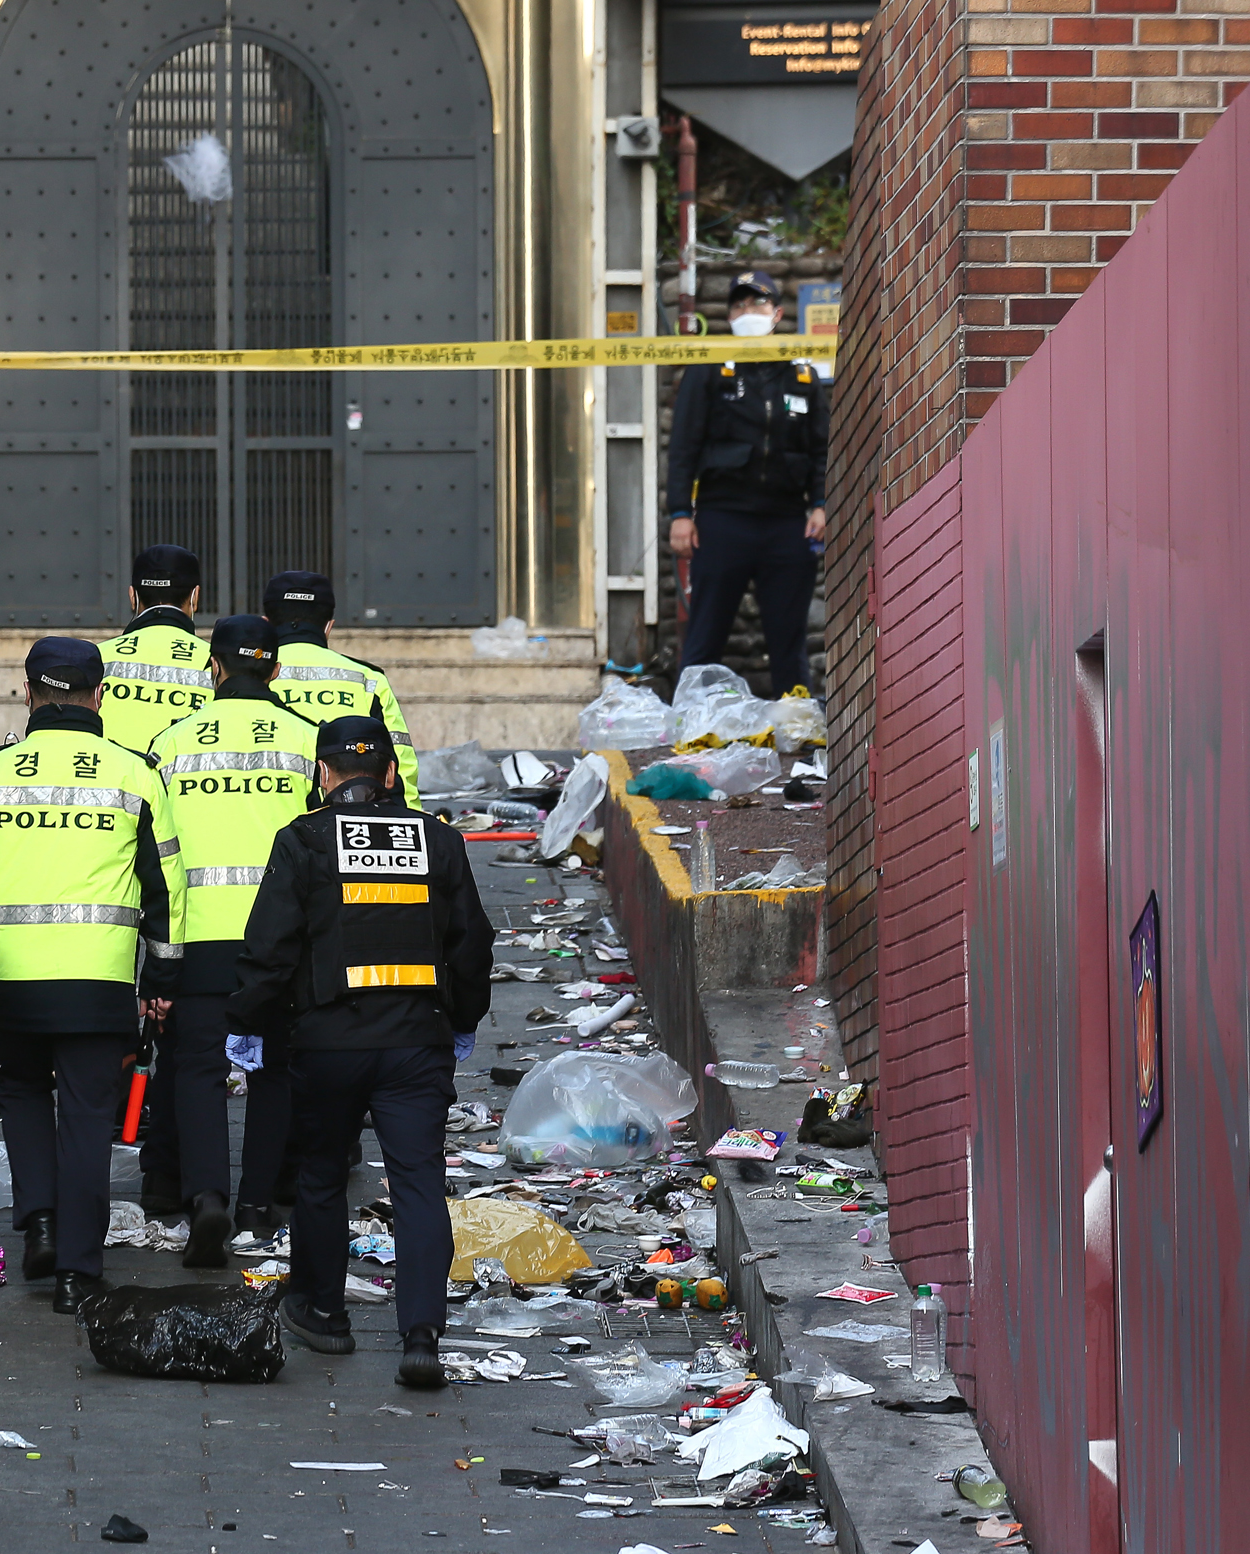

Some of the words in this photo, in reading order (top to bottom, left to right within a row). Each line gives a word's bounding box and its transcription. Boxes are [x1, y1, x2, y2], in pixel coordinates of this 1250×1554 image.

[143, 579, 168, 587] POLICE
[42, 675, 68, 689] POLICE
[179, 776, 293, 795] POLICE
[348, 855, 419, 868] POLICE
